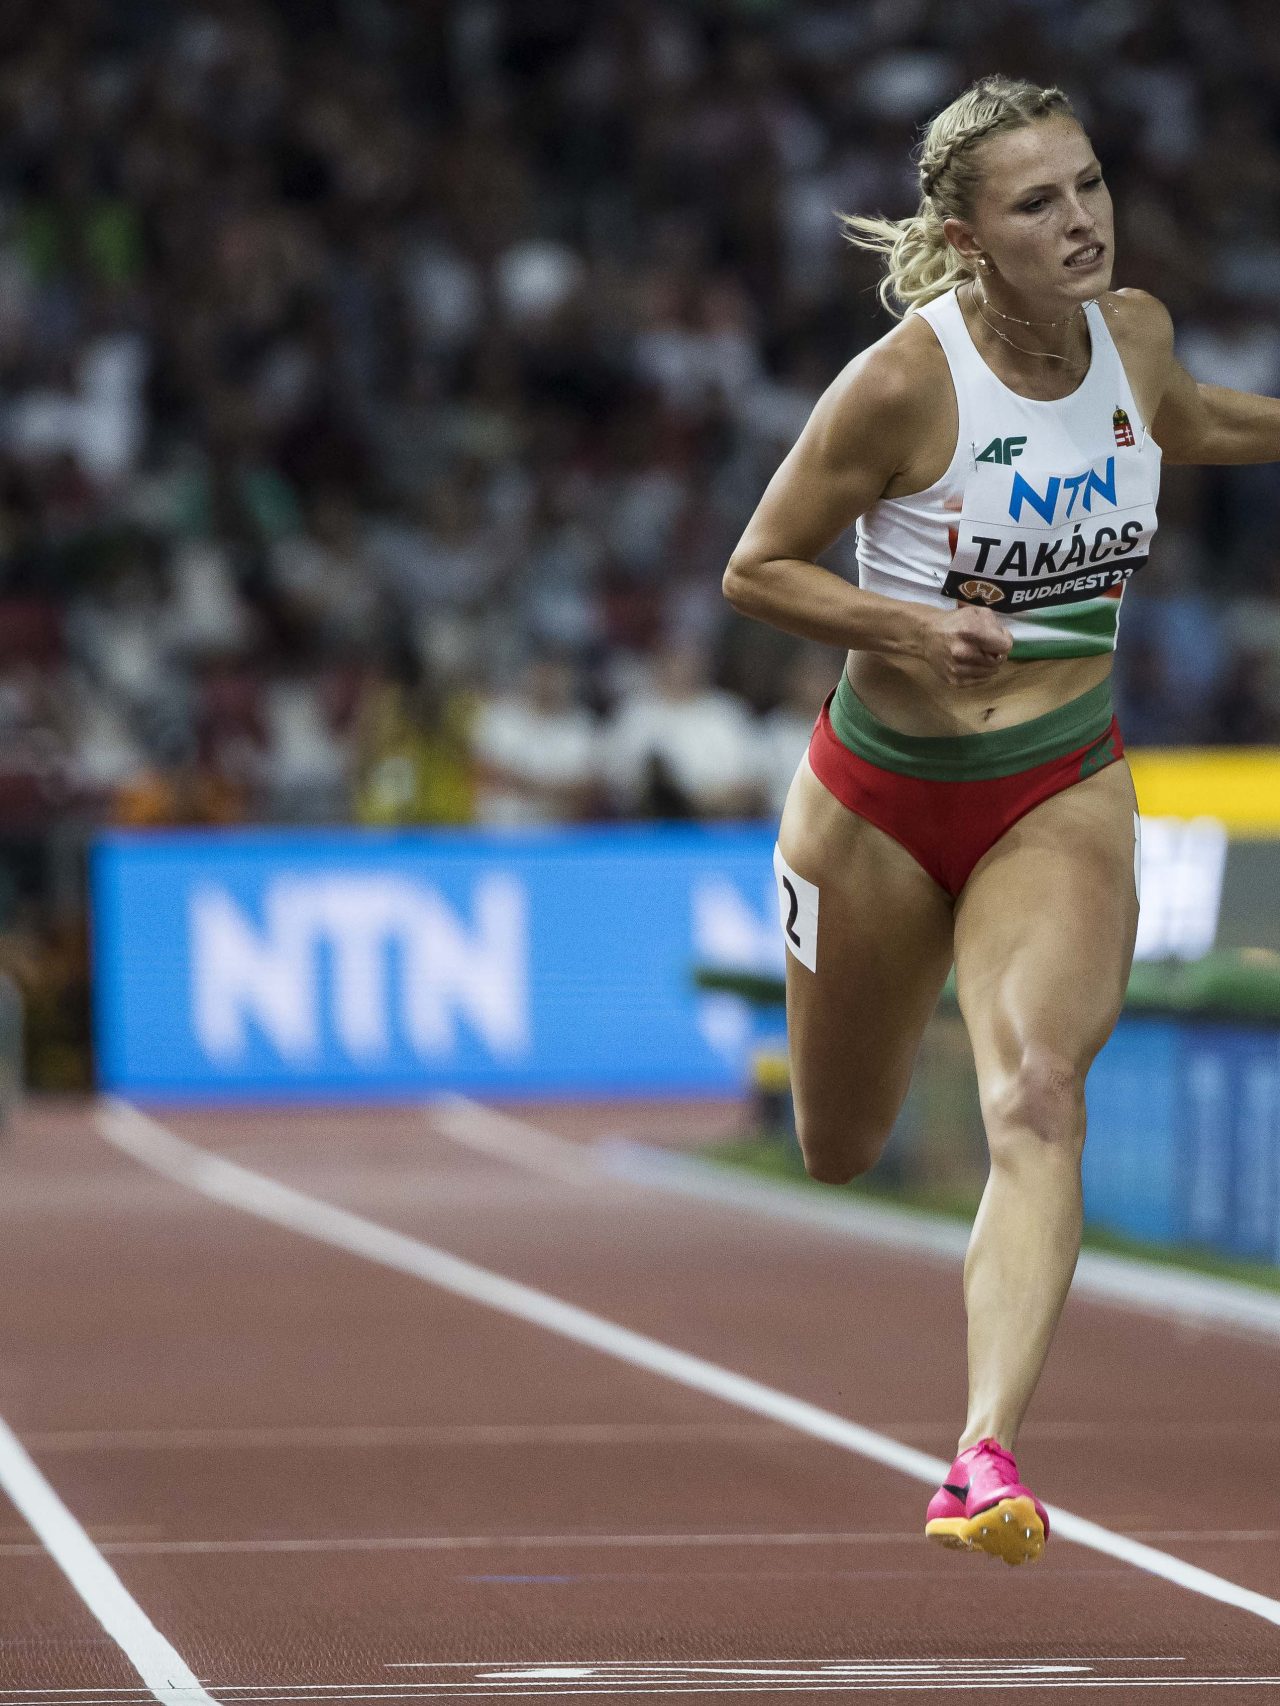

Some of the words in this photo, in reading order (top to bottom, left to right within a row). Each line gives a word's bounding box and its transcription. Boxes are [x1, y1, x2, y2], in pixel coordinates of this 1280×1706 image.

[1008, 455, 1118, 526] NTN
[971, 520, 1144, 578] TAKÁCS
[1010, 571, 1110, 604] BUDAPEST
[782, 874, 801, 949] 2
[189, 870, 532, 1075] NTN
